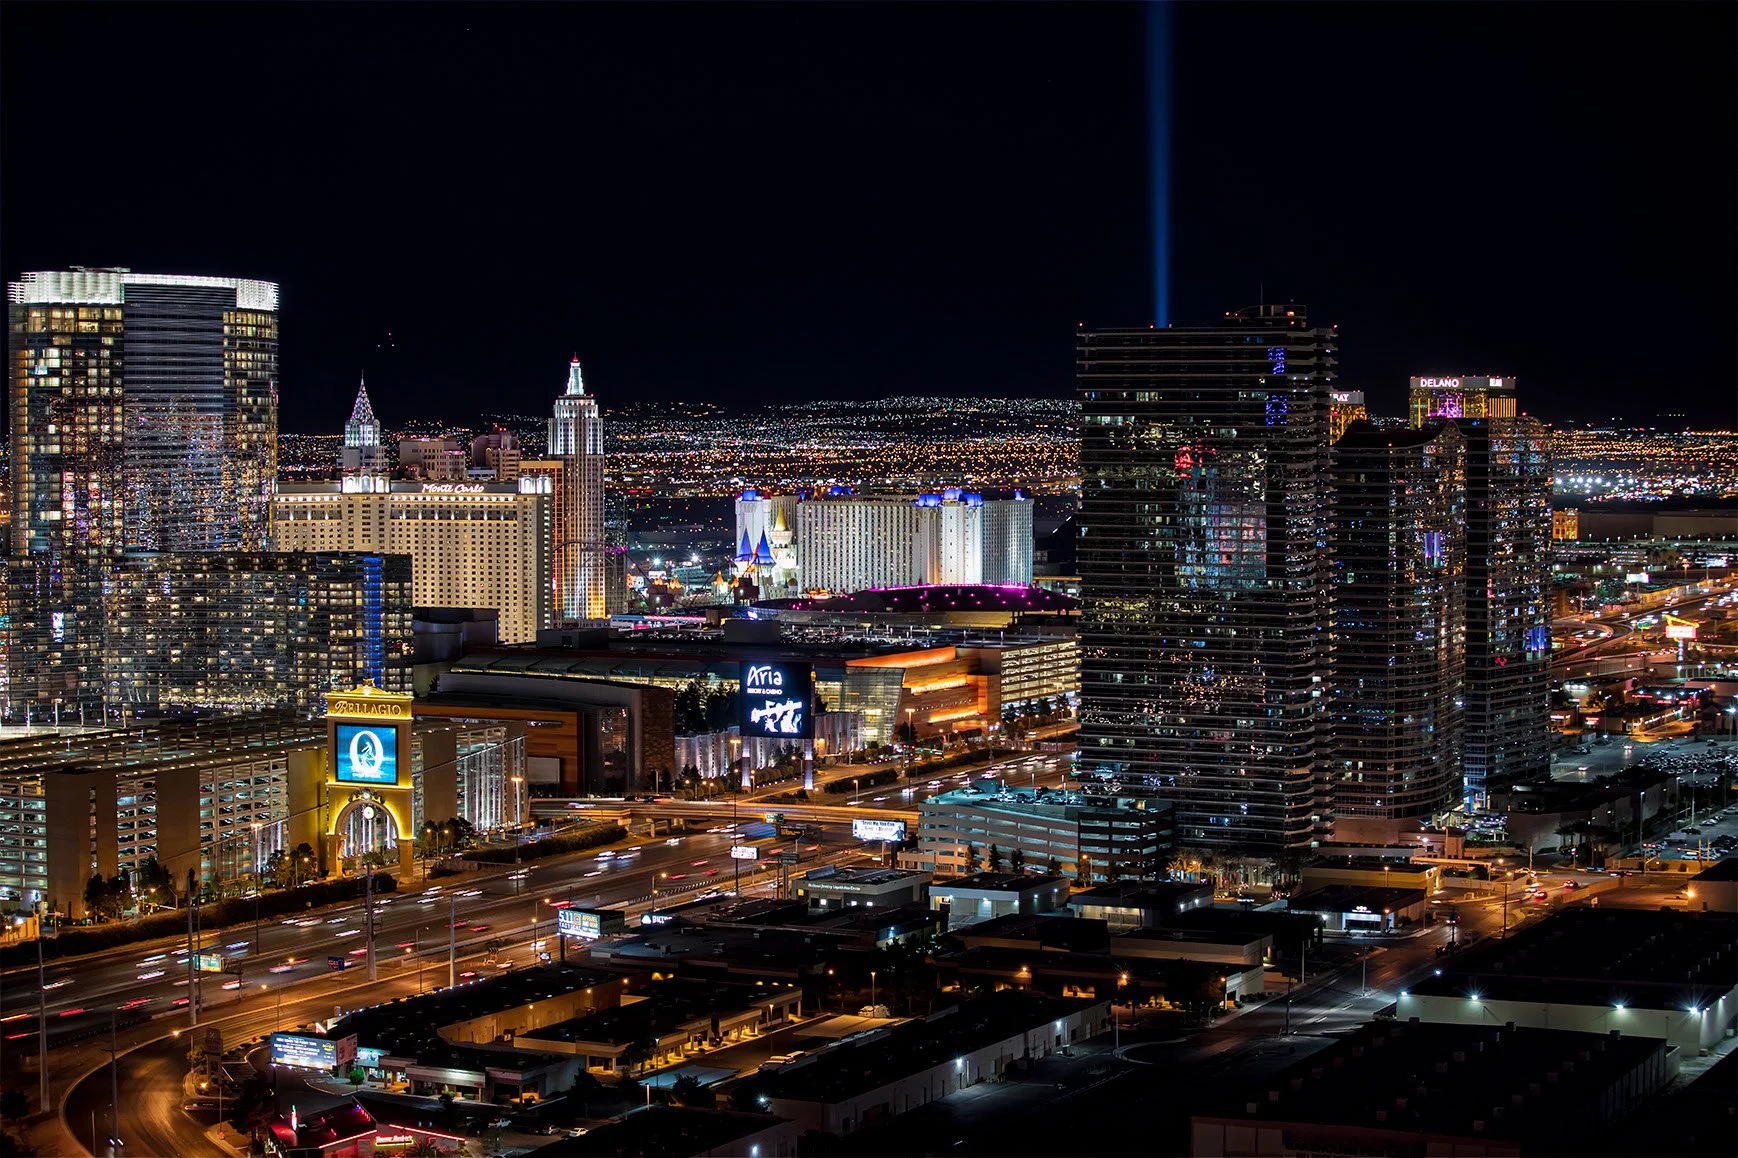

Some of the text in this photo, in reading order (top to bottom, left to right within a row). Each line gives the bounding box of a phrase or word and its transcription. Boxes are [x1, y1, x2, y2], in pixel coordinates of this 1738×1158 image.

[1420, 378, 1459, 387] DELANO
[1332, 393, 1350, 402] BAY
[421, 483, 485, 494] Monte Carlo
[747, 666, 783, 687] Aria
[334, 700, 402, 717] BELLAGIO
